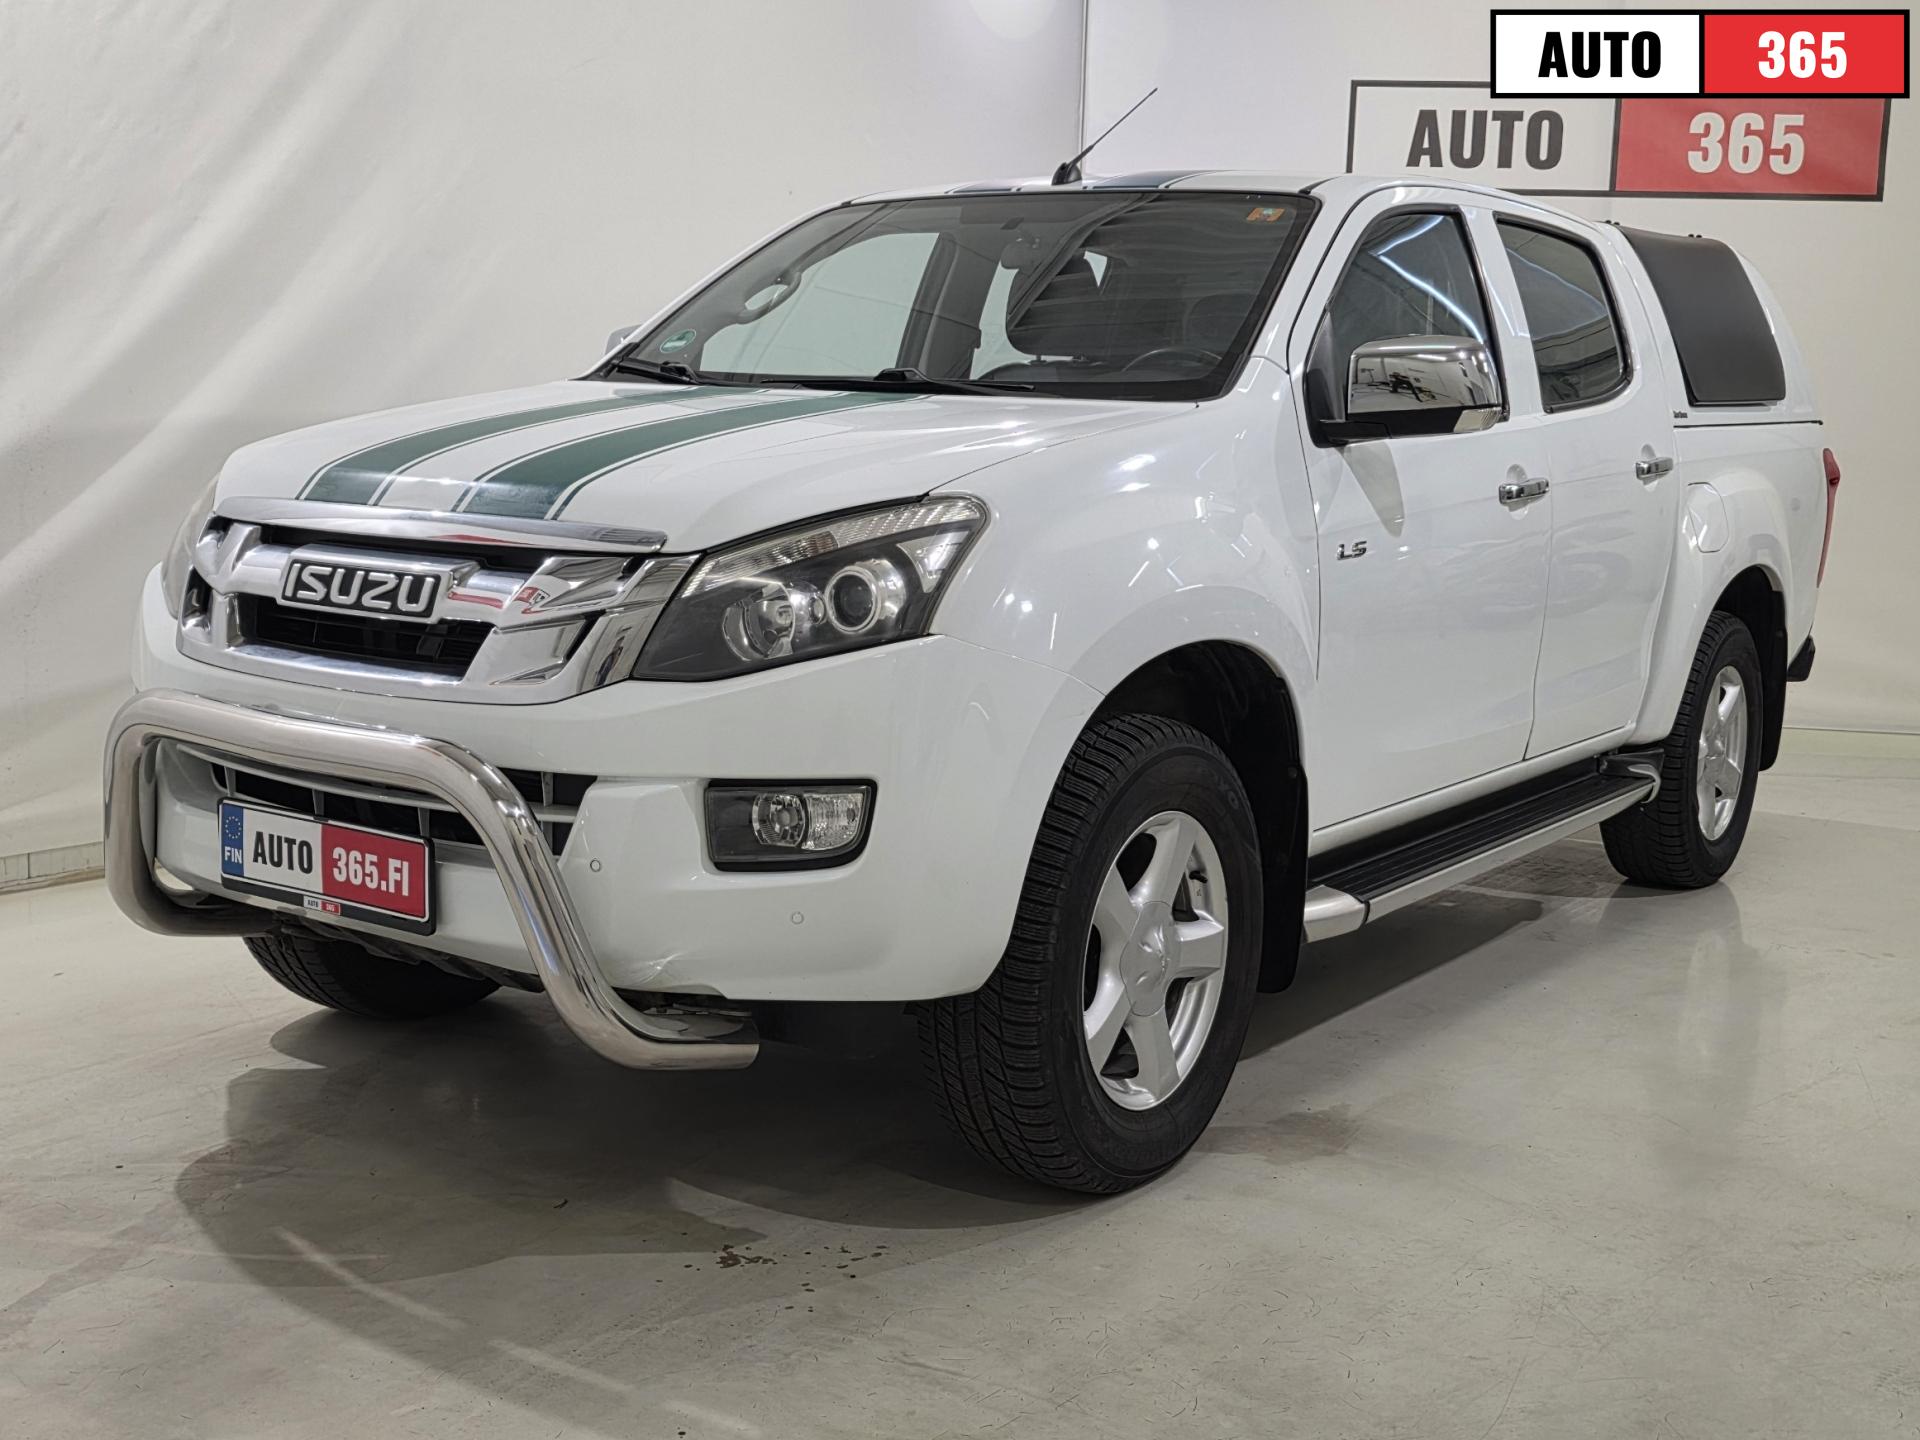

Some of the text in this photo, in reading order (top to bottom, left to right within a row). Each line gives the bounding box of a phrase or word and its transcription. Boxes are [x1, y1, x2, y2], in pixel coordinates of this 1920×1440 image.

[1405, 109, 1805, 174] AUTO 365
[1336, 540, 1367, 560] LS
[285, 563, 436, 612] ISUZU
[224, 846, 242, 864] FIN
[252, 831, 409, 897] AUTO 365.FI
